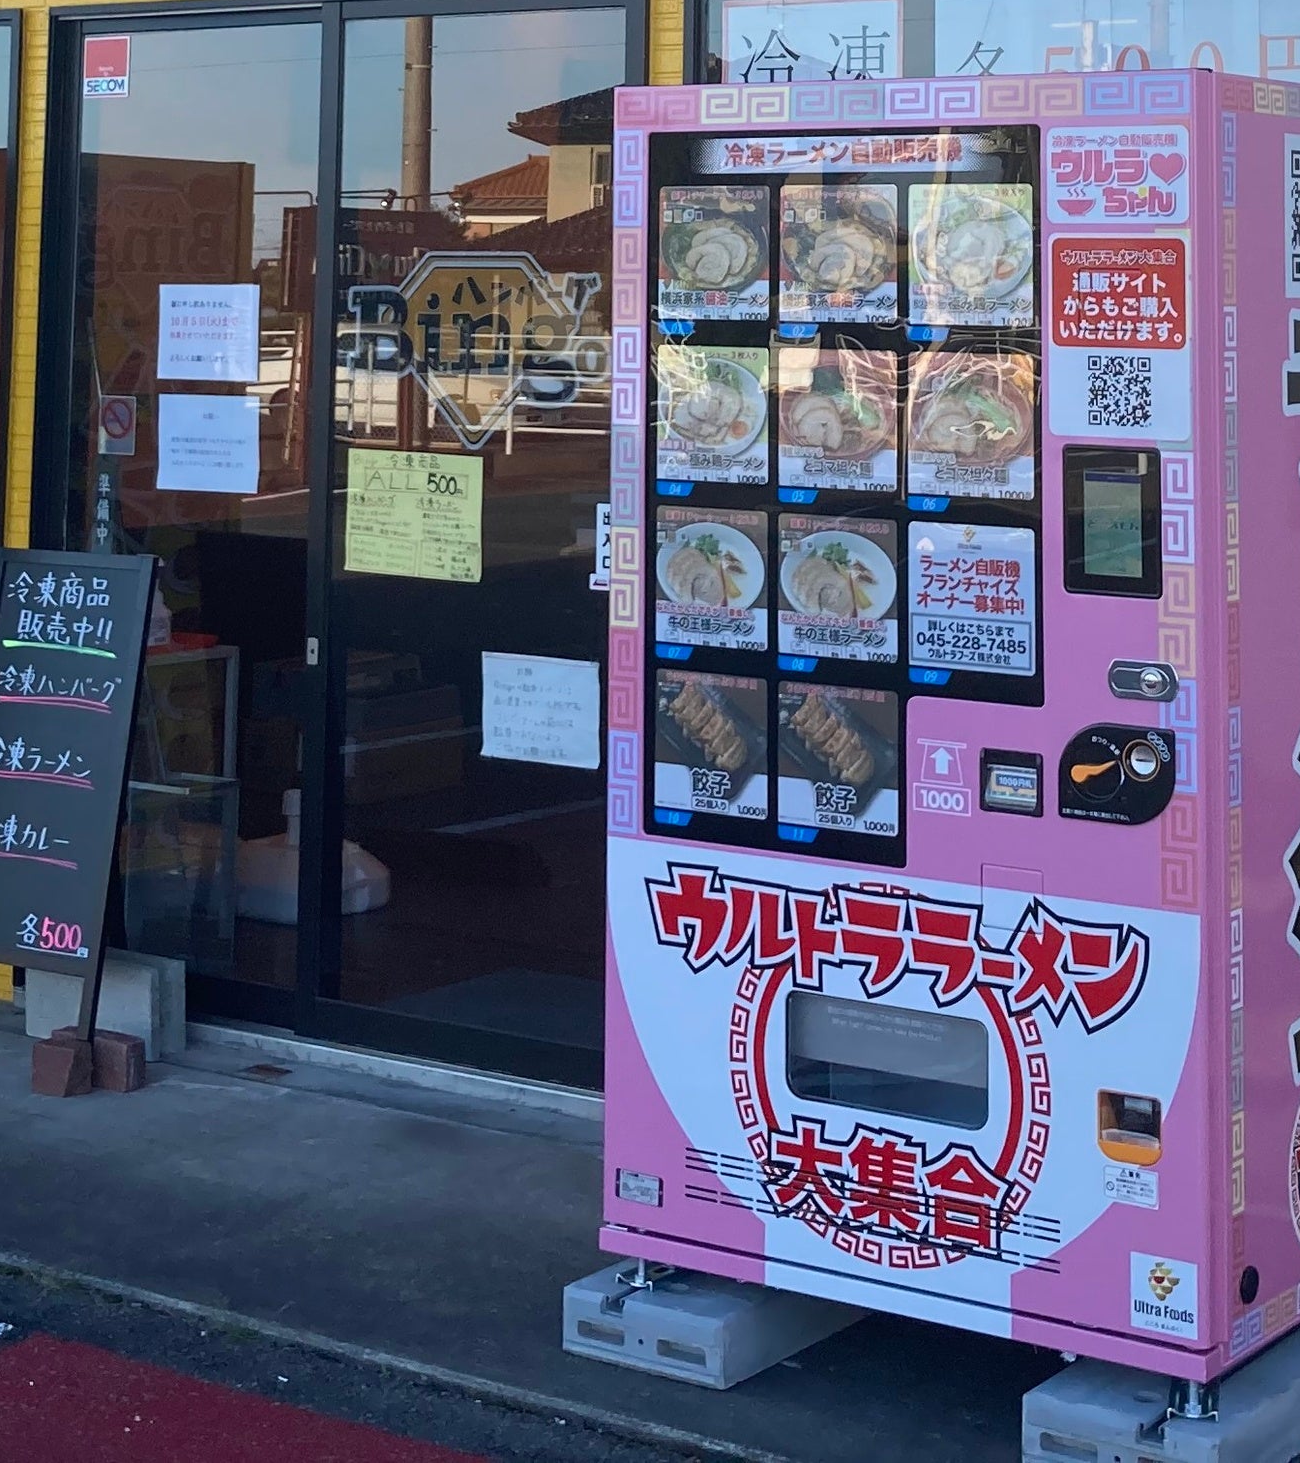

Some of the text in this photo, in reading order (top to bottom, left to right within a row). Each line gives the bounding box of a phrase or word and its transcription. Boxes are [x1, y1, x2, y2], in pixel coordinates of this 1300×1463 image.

[86, 79, 125, 93] SECOM
[1050, 149, 1148, 187] ウルラ
[1102, 186, 1176, 217] ちゃん
[452, 273, 601, 312] ハンバーグ
[1072, 271, 1166, 294] 通販サイト
[1063, 296, 1179, 318] からもご購入
[1059, 319, 1183, 343] いただけます。
[348, 286, 609, 408] Bingo
[366, 470, 419, 491] ALL
[922, 498, 936, 509] 06
[919, 555, 1021, 579] ラーメン自販機
[7, 571, 111, 610] 冷凍商品
[921, 573, 1020, 596] フランチャイズ
[928, 620, 1014, 638] 詳しくはこちらまで
[668, 646, 681, 657] 07
[916, 632, 1027, 654] 045-228-7485
[791, 659, 805, 670] 08
[923, 670, 938, 682] 09
[691, 768, 730, 796] 餃子
[694, 798, 727, 810] 25個入り
[814, 782, 857, 812] 餃子
[920, 788, 965, 812] 1000
[668, 813, 681, 824] 10
[737, 804, 767, 817] 1,000円
[818, 813, 853, 827] 25個入り
[792, 828, 804, 839] 11
[863, 819, 896, 834] 1,000円
[645, 861, 1149, 1034] ウルトララーメン
[758, 1114, 1012, 1260] 大集合
[1133, 1299, 1195, 1324] Ultra Foods
